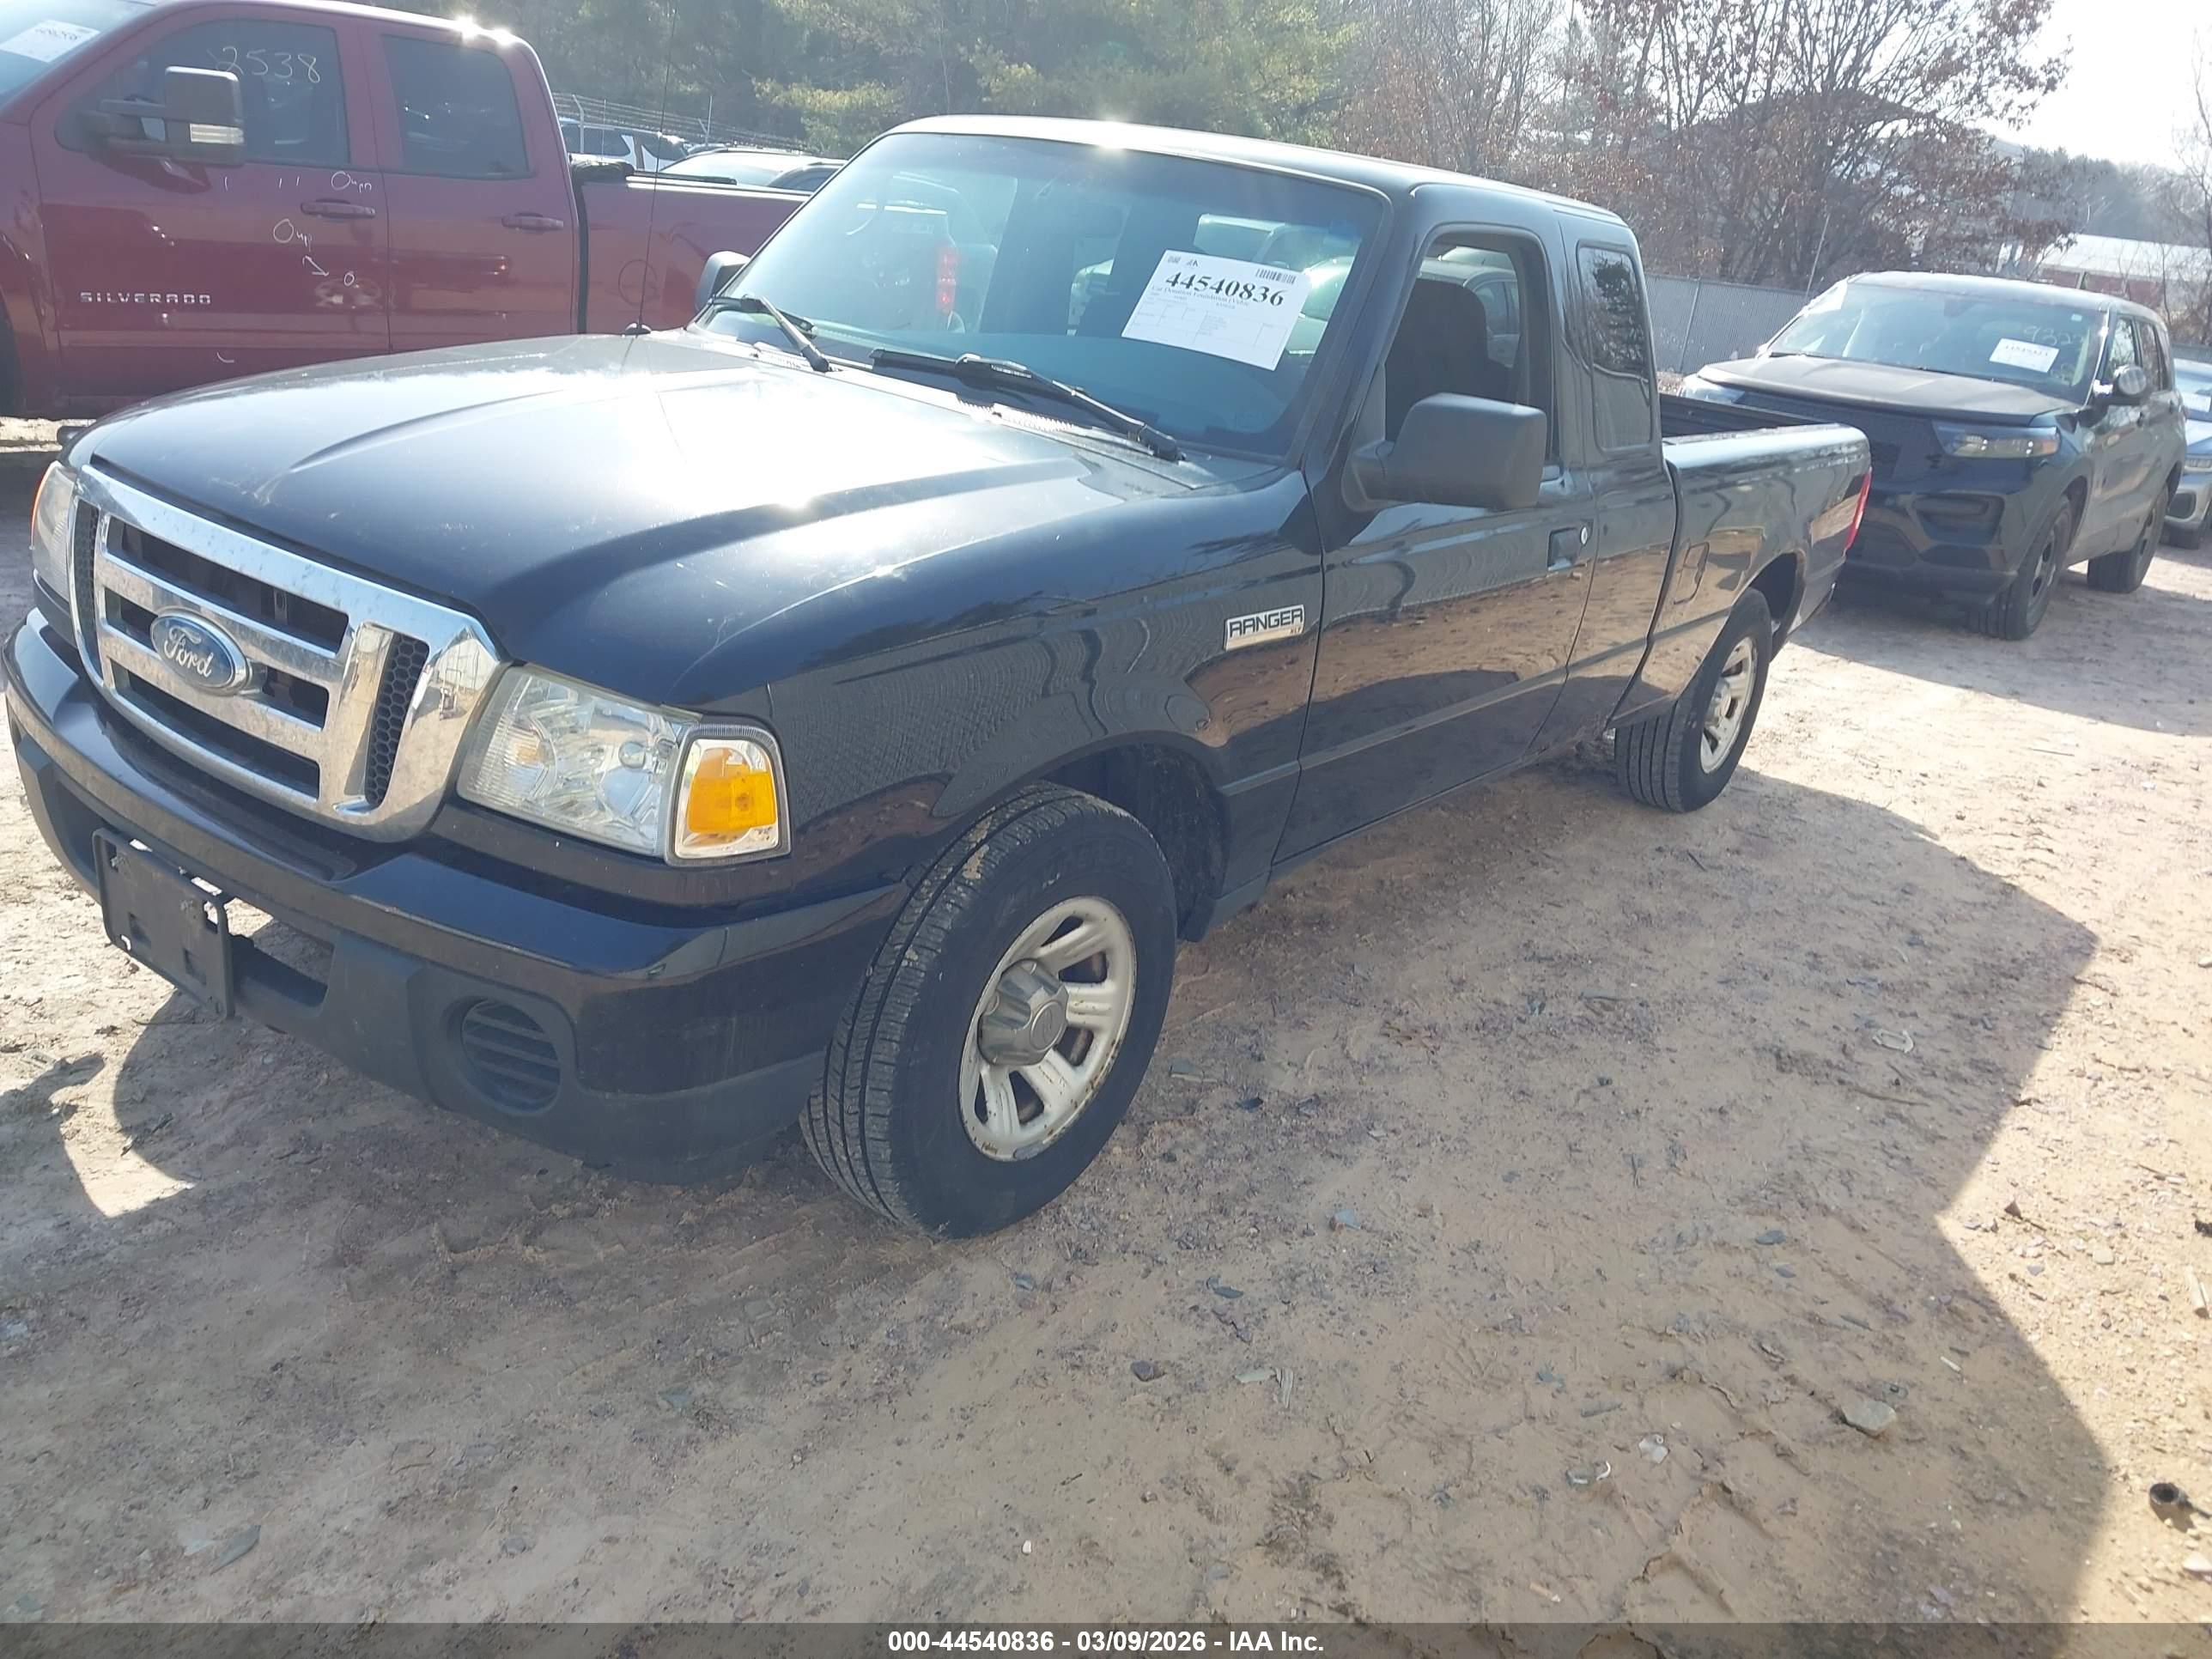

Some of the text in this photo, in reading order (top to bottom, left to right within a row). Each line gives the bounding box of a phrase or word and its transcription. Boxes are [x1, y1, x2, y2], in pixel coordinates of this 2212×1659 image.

[80, 292, 211, 304] SILVERADO
[1165, 270, 1288, 307] 44540836
[1229, 608, 1304, 638] RANGER
[164, 626, 214, 678] Ford
